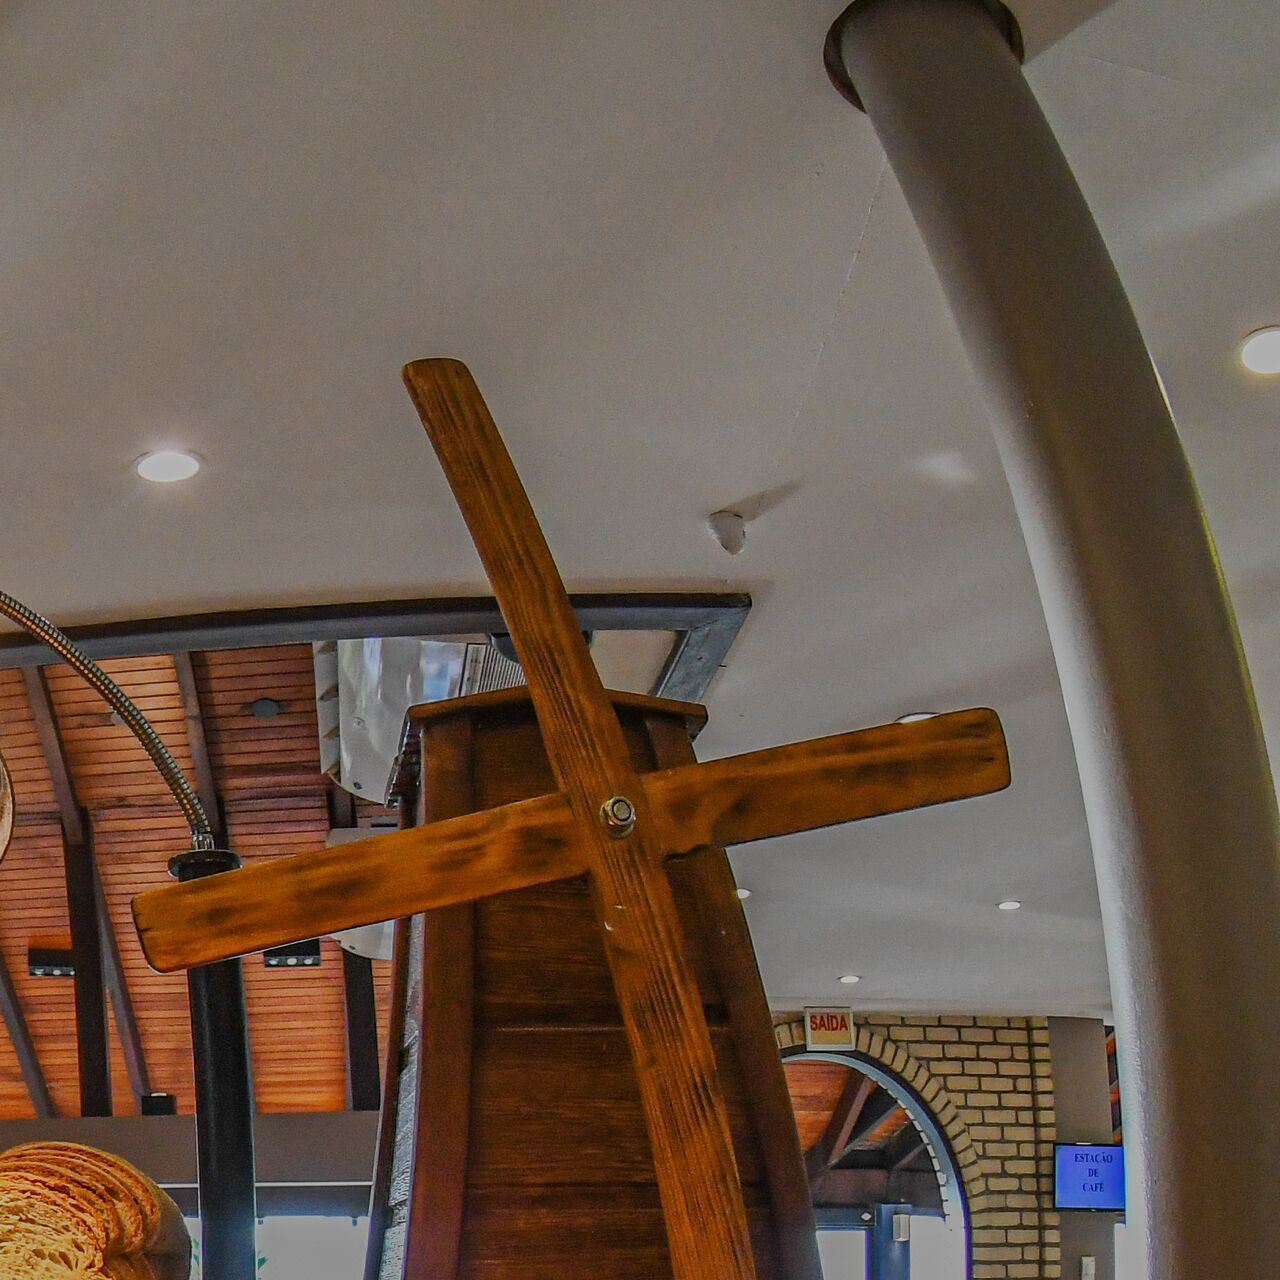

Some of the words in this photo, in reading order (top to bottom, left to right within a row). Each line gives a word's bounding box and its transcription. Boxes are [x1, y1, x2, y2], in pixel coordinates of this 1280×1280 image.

[810, 1013, 848, 1031] SAÍDA
[1074, 1152, 1113, 1164] ESTAÇÃO
[1088, 1168, 1100, 1178] DE
[1082, 1181, 1104, 1193] CAFÉ
